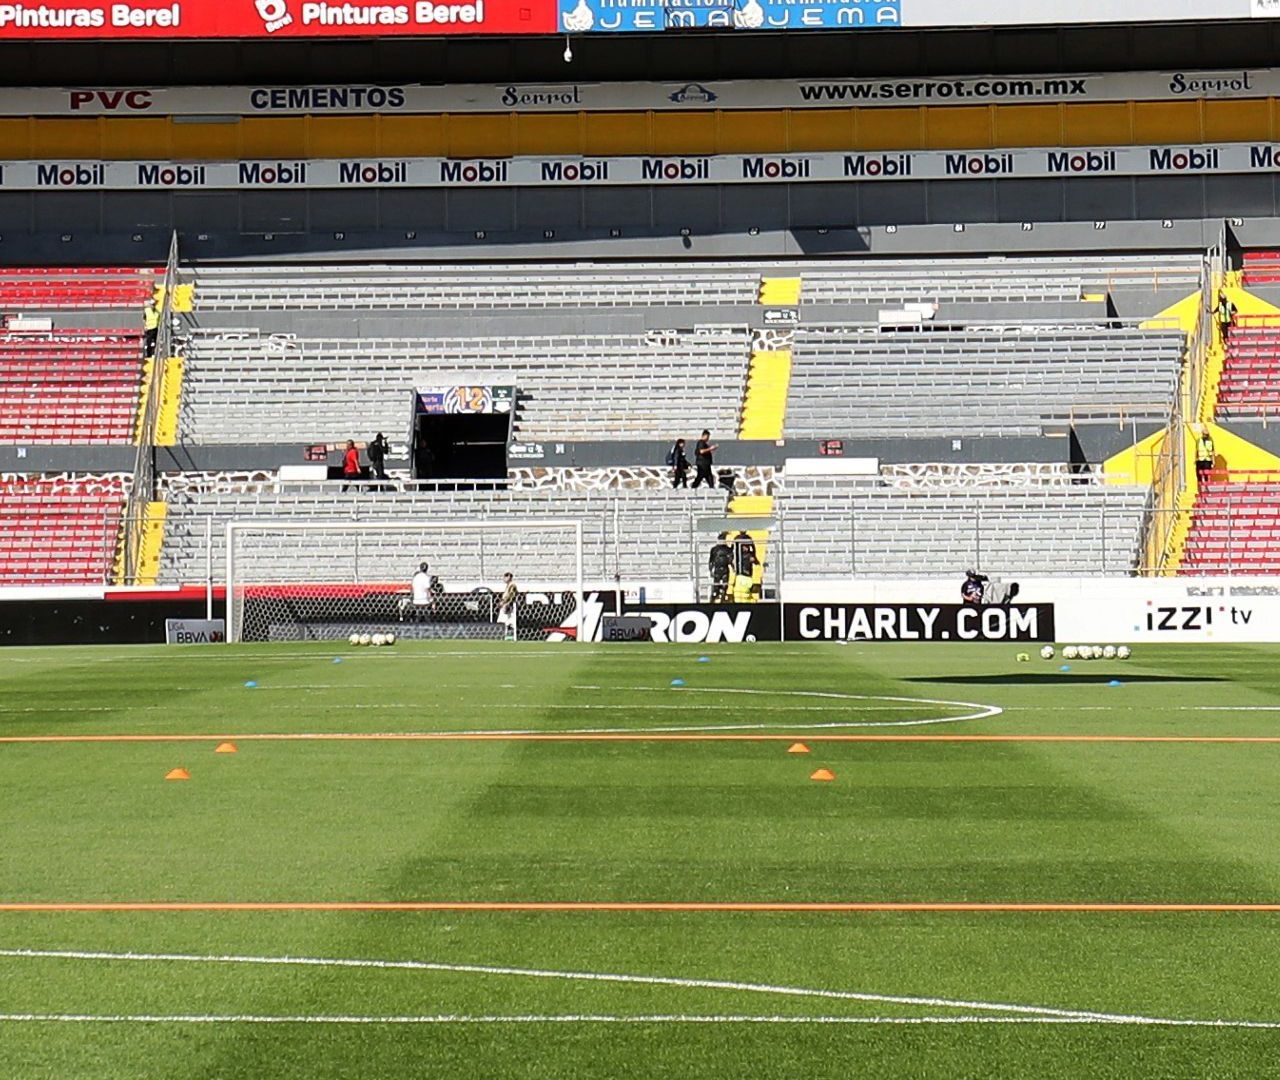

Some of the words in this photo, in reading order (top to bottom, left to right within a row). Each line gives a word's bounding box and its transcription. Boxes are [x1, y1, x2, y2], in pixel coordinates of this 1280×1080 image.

[112, 4, 180, 28] Berel
[302, 1, 409, 25] Pinturas
[415, 0, 484, 23] Berel
[768, 7, 898, 27] JEMA
[800, 77, 1086, 101] www.serrot.com.mx
[1170, 71, 1252, 93] Serrot
[70, 91, 152, 109] PVC
[251, 88, 405, 108] CEMENTOS
[502, 86, 583, 107] Serrot
[37, 164, 104, 186] Mobil
[138, 164, 205, 185] Mobil
[238, 163, 306, 184] Mobil
[339, 162, 406, 183] Mobil
[440, 161, 507, 182] Mobil
[541, 160, 608, 181] Mobil
[642, 159, 709, 180] Mobil
[742, 157, 810, 178] Mobil
[843, 155, 911, 176] Mobil
[945, 153, 1013, 175] Mobil
[1047, 150, 1115, 172] Mobil
[1150, 147, 1218, 170] Mobil
[455, 387, 484, 411] 12
[546, 592, 751, 642] ARON
[798, 607, 1039, 639] CHARLY.COM
[1231, 606, 1252, 624] tv
[176, 632, 207, 643] BBVA
